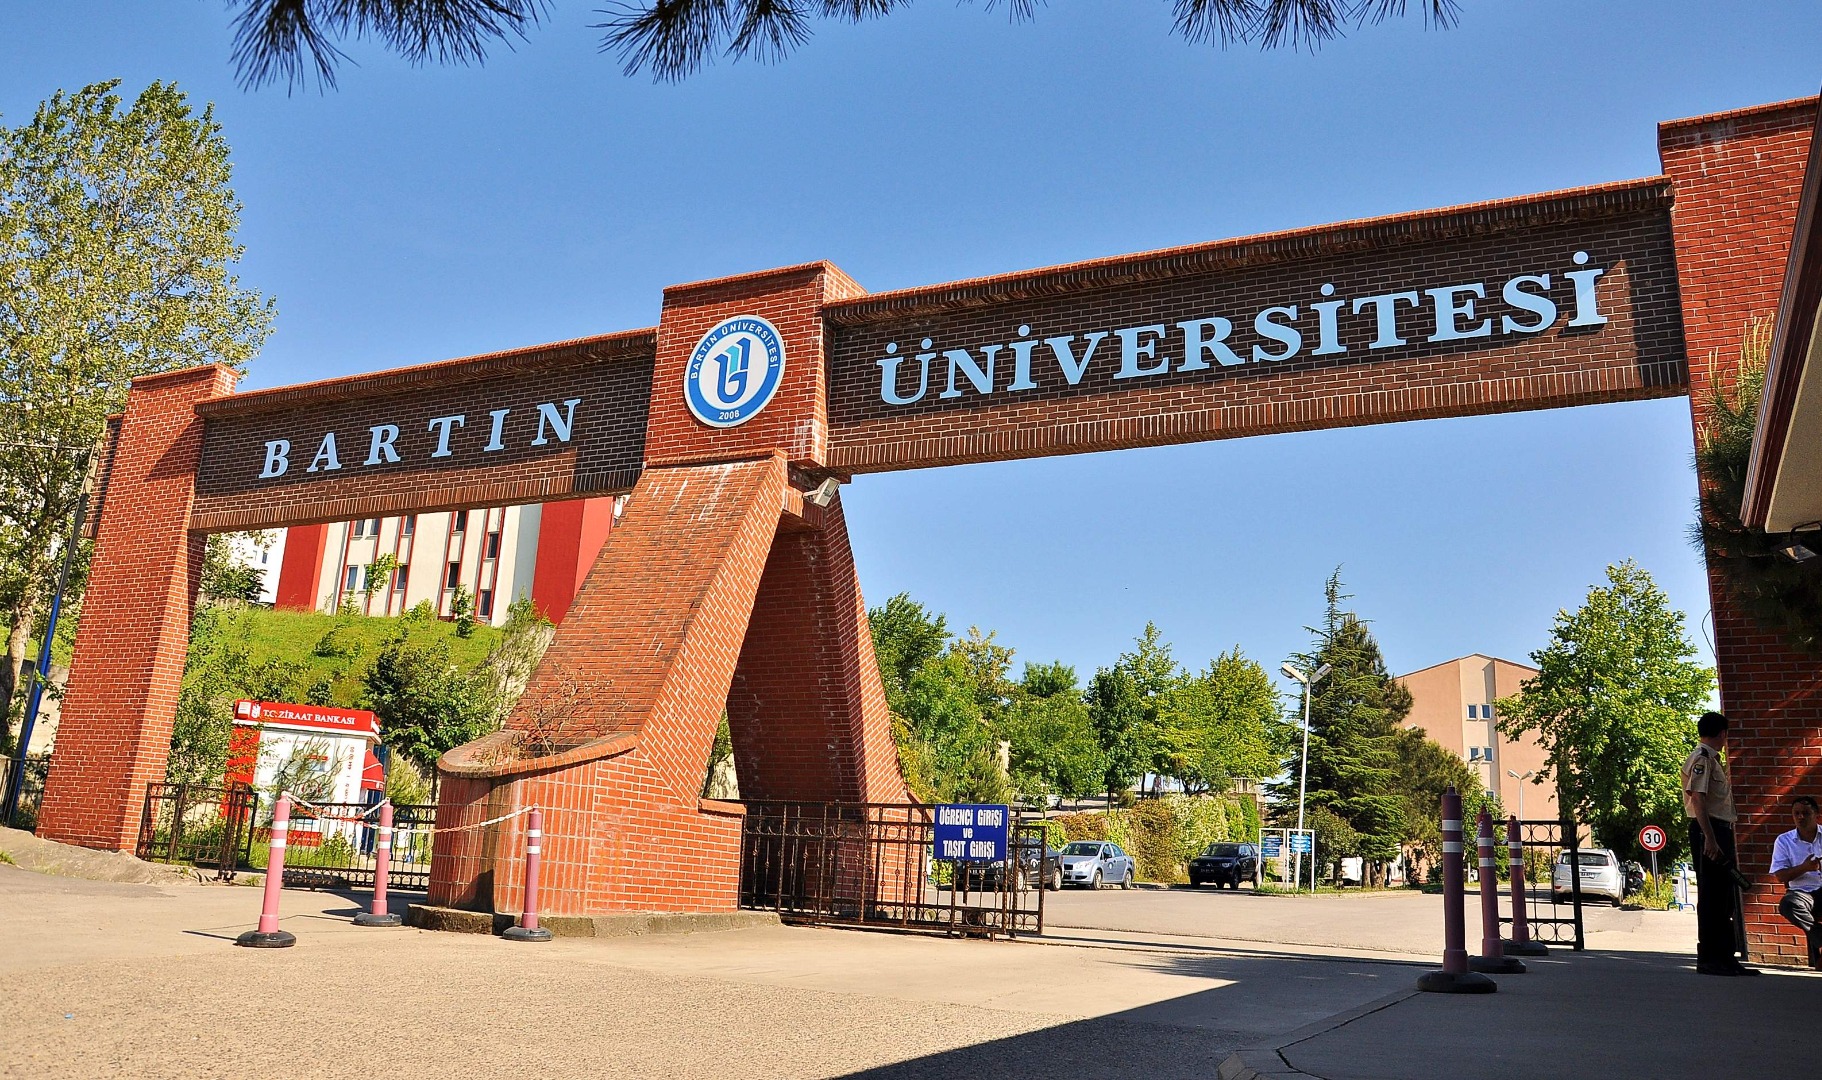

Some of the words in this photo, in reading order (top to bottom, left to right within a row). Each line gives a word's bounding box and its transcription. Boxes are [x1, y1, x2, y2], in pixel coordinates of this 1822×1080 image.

[875, 250, 1609, 406] ÜNİVERSİTESİ
[690, 334, 718, 379] BARTIN
[718, 409, 740, 420] 2008
[258, 398, 582, 480] BARTIN
[278, 709, 313, 721] ZİRAAT
[314, 713, 356, 725] BANKASI
[962, 827, 973, 839] ve
[1644, 832, 1661, 845] 30
[942, 839, 966, 859] TAŞIT
